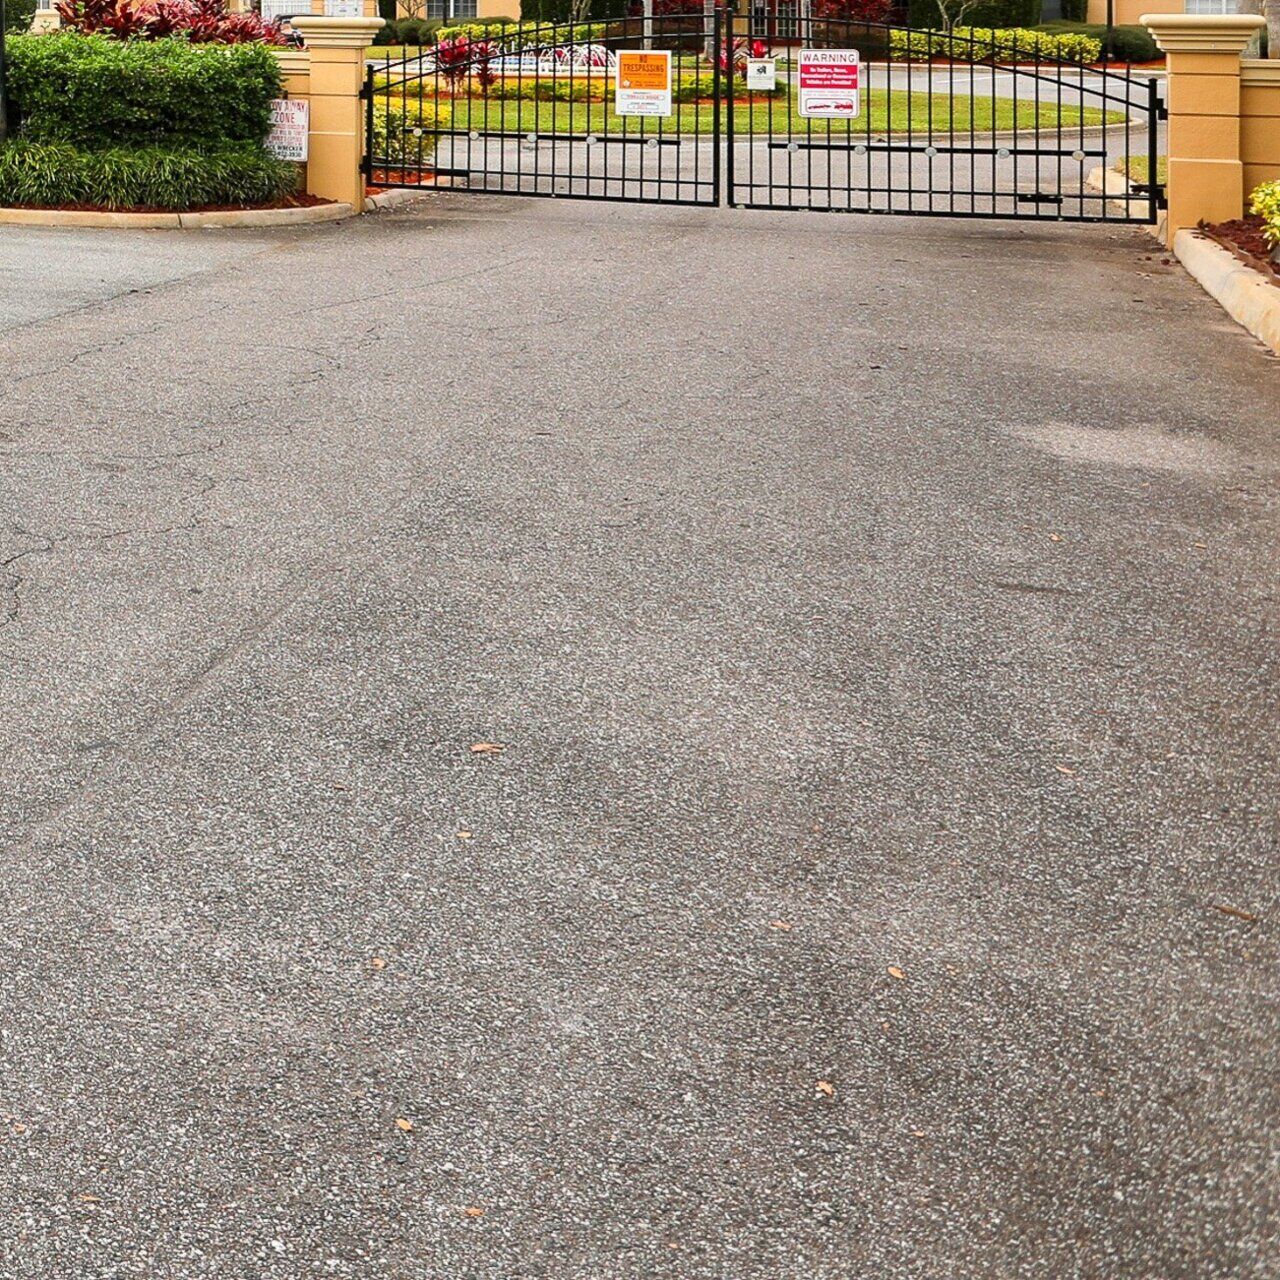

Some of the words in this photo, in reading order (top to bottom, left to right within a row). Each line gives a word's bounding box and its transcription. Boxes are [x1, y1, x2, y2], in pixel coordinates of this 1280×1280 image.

[803, 53, 855, 63] WARNING
[623, 63, 665, 73] TRESPASSING
[274, 112, 295, 123] ZONE
